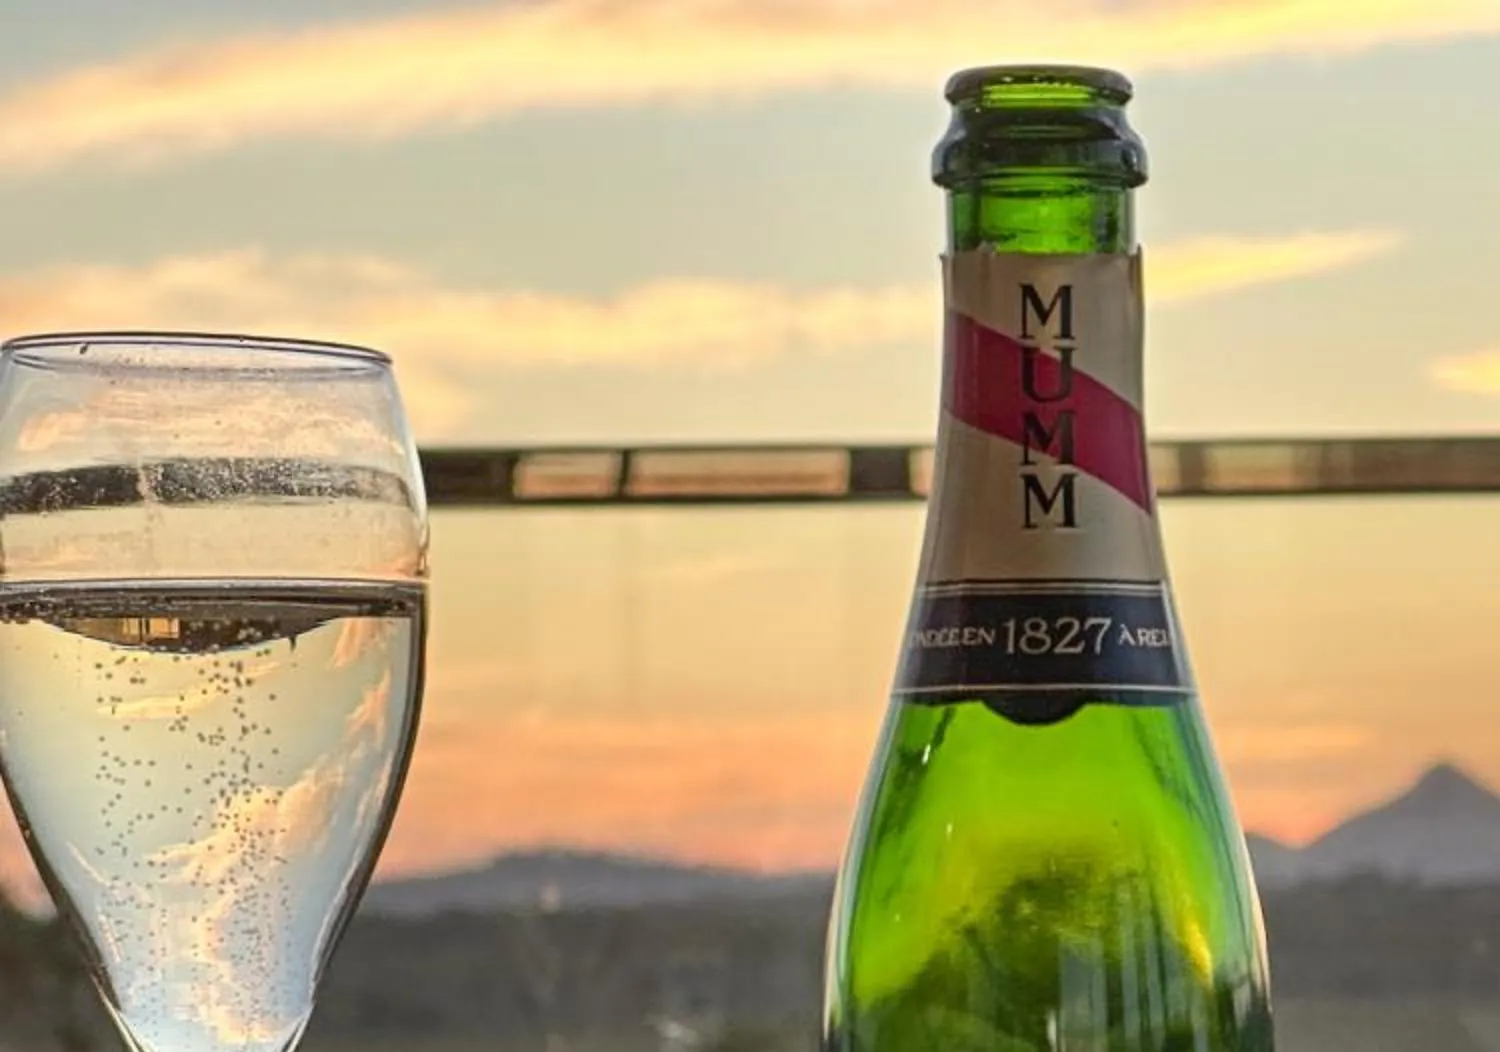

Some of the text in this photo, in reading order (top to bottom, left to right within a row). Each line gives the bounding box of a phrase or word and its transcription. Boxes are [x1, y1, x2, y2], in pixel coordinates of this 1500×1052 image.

[1018, 283, 1078, 528] MUMM
[962, 626, 996, 646] EN
[1002, 617, 1112, 654] 1827
